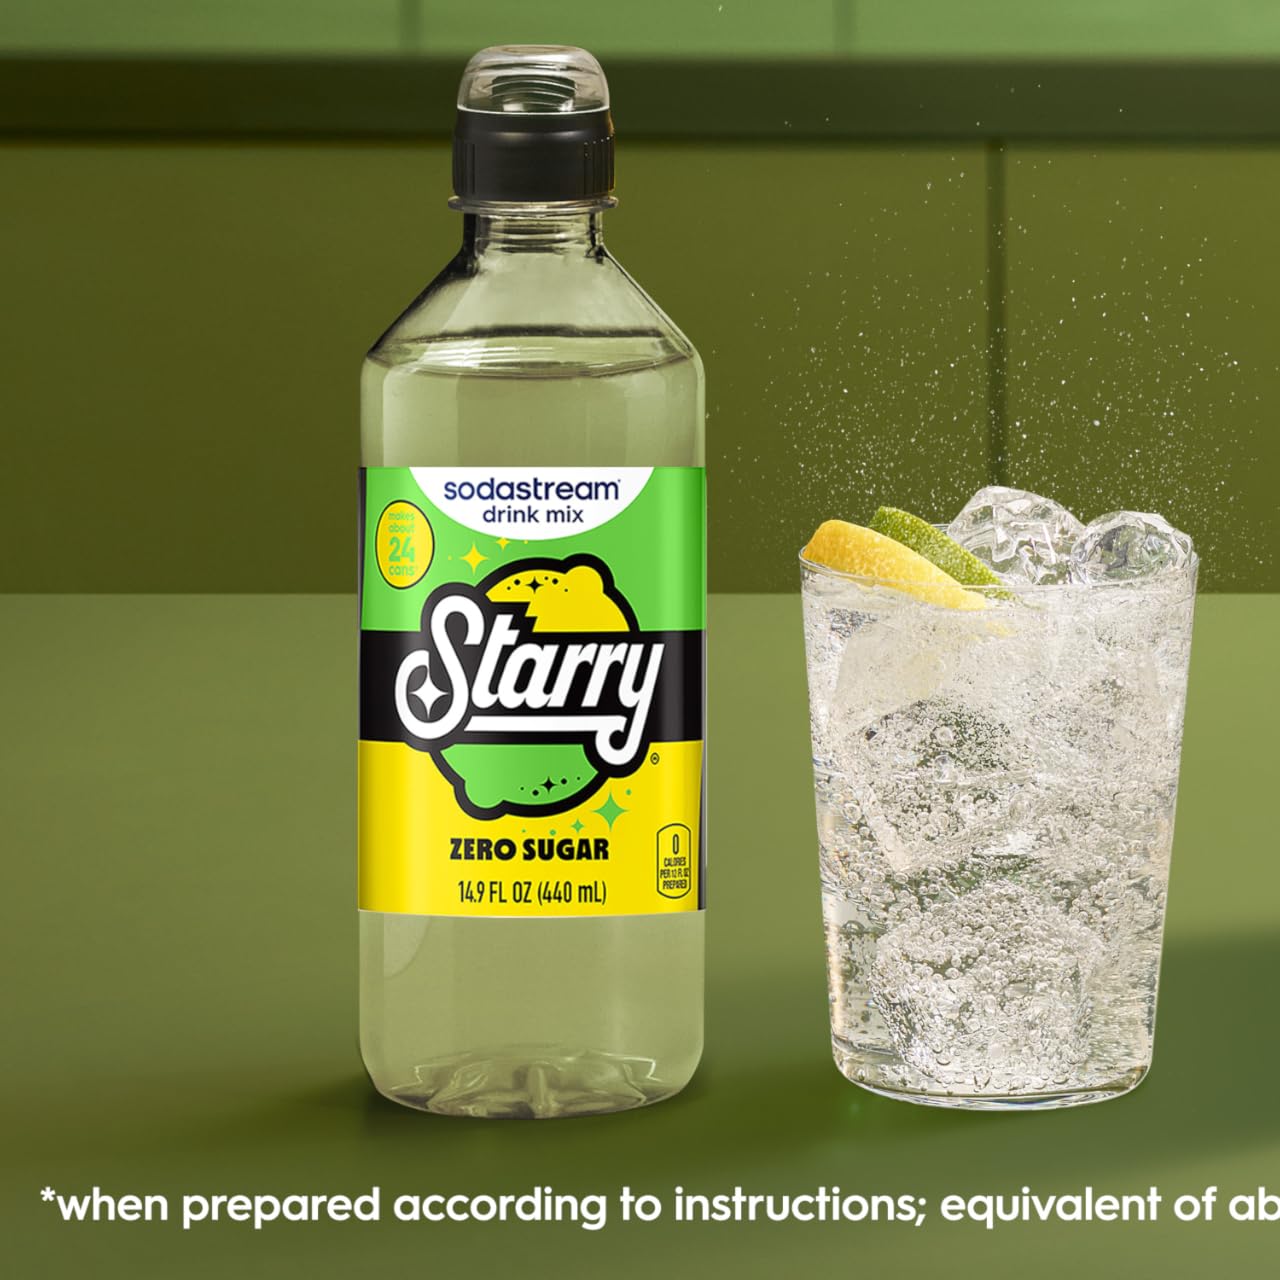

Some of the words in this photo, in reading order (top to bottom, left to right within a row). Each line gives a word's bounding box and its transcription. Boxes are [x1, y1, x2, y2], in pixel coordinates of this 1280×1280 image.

[444, 477, 621, 501] sodastream
[388, 512, 415, 521] makes
[482, 505, 540, 523] drink
[546, 505, 584, 523] mix
[388, 523, 415, 534] about
[388, 536, 415, 562] 24
[395, 595, 665, 765] Starry
[449, 837, 517, 861] ZERO
[522, 837, 609, 862] SUGAR
[458, 880, 485, 903] 14.9
[489, 880, 508, 904] FL
[512, 880, 532, 904] OZ
[537, 880, 572, 906] (440
[578, 880, 607, 906] mL)
